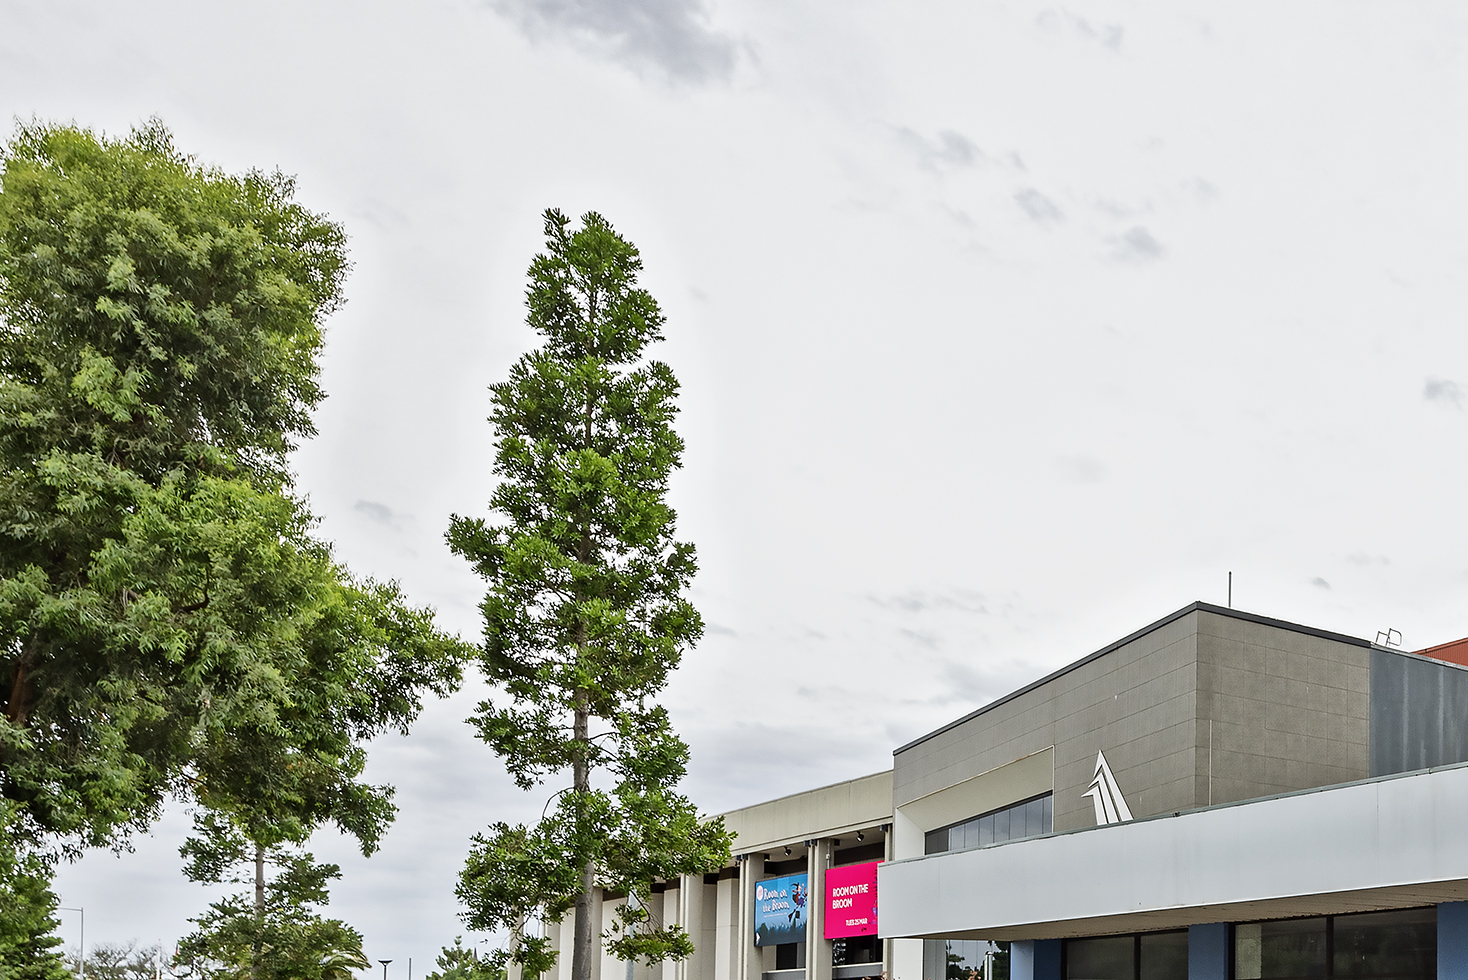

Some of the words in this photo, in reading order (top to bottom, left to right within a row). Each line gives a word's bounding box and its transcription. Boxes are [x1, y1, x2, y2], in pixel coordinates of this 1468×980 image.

[763, 888, 779, 900] Room
[779, 889, 788, 898] on
[833, 886, 849, 897] ROOM
[849, 885, 858, 895] ON
[858, 883, 868, 894] THE
[762, 903, 771, 913] the
[772, 899, 790, 912] Broom
[832, 898, 852, 909] BROOM
[845, 918, 854, 926] TUES
[859, 917, 868, 925] MAR
